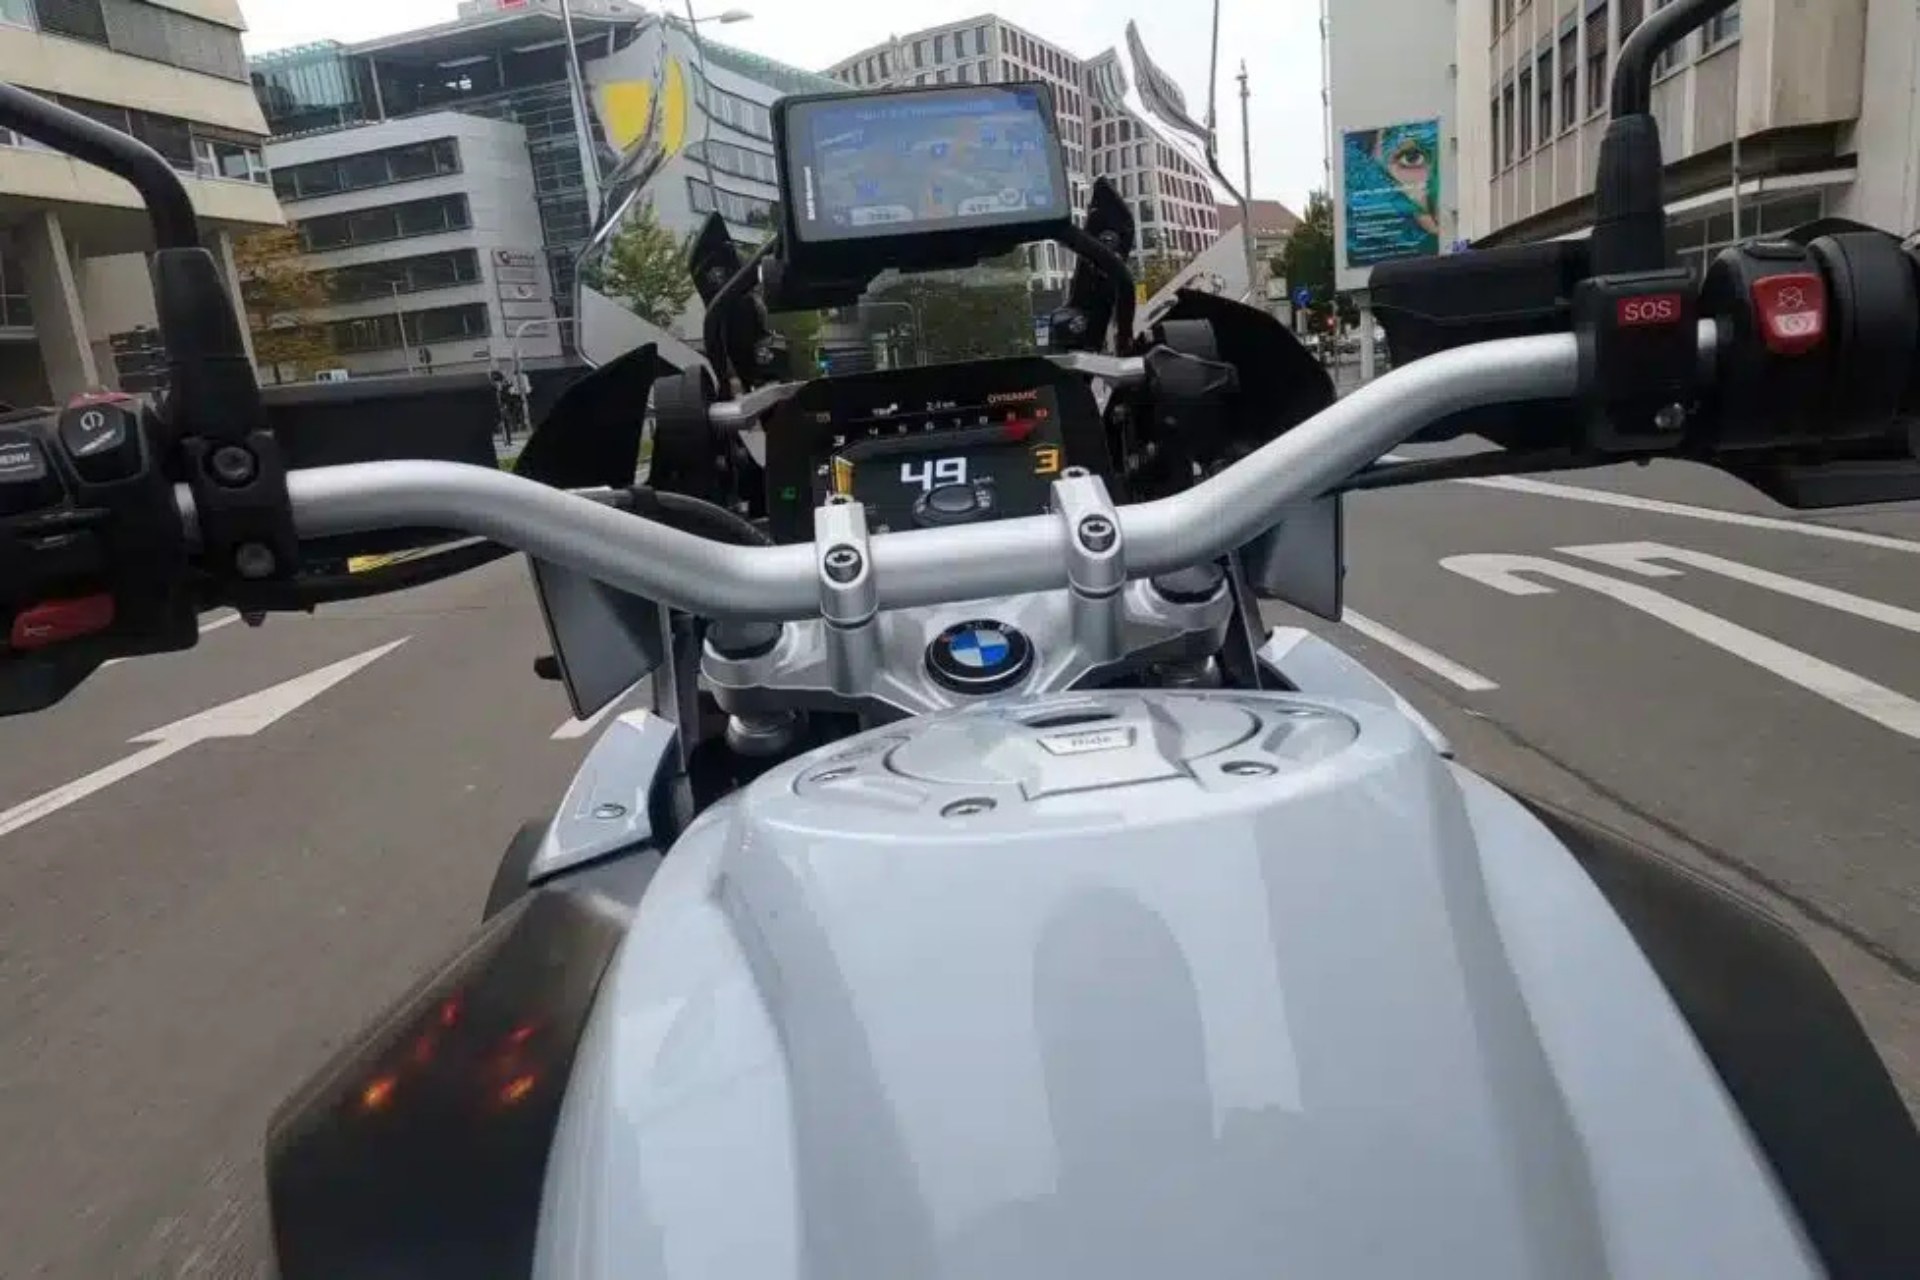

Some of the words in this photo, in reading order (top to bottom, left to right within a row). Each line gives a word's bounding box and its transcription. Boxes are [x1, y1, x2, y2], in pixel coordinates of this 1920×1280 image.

[1624, 300, 1672, 322] SOS
[987, 390, 1038, 404] DYNAMIC
[832, 435, 845, 447] 3
[1035, 450, 1059, 474] 3
[901, 457, 967, 490] 49
